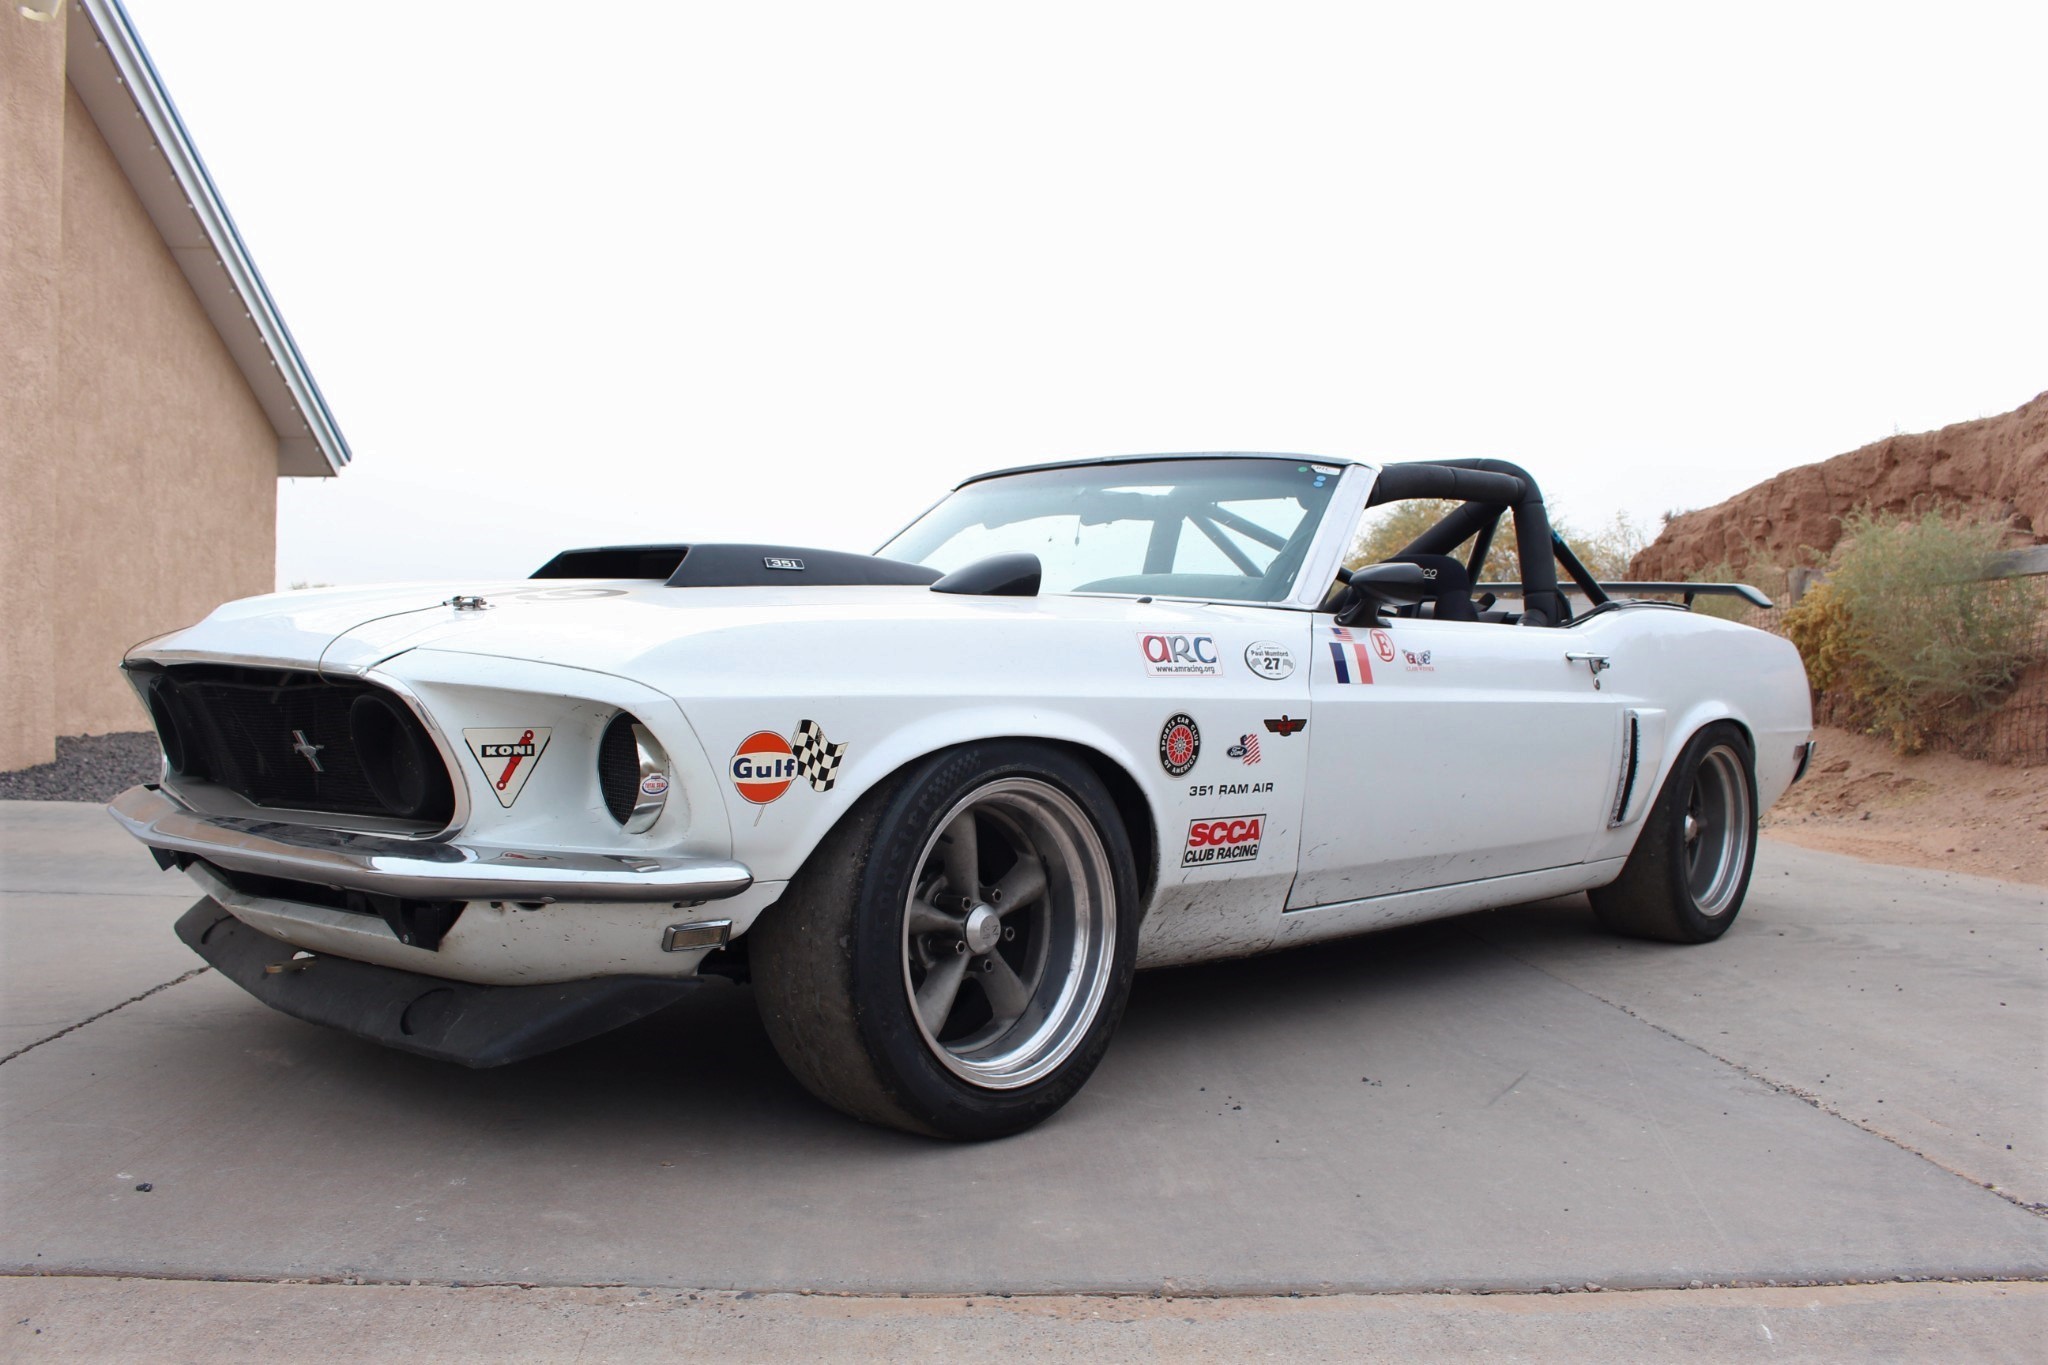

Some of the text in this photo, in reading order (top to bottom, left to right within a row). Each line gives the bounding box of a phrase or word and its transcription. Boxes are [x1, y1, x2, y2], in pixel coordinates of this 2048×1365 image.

[770, 559, 798, 568] 351
[1373, 632, 1392, 656] E
[1155, 665, 1215, 674] www.amracing.org
[1263, 657, 1280, 670] 27
[1161, 716, 1199, 751] SPORTS CAR CLUB
[485, 745, 533, 756] KONI
[1230, 747, 1245, 757] Ford
[733, 757, 796, 779] Gulf
[1164, 754, 1196, 773] OF AMERICA
[1189, 782, 1274, 797] 351 RAM AIR
[1188, 819, 1260, 847] SCCA
[1184, 844, 1258, 863] CLUB RACING
